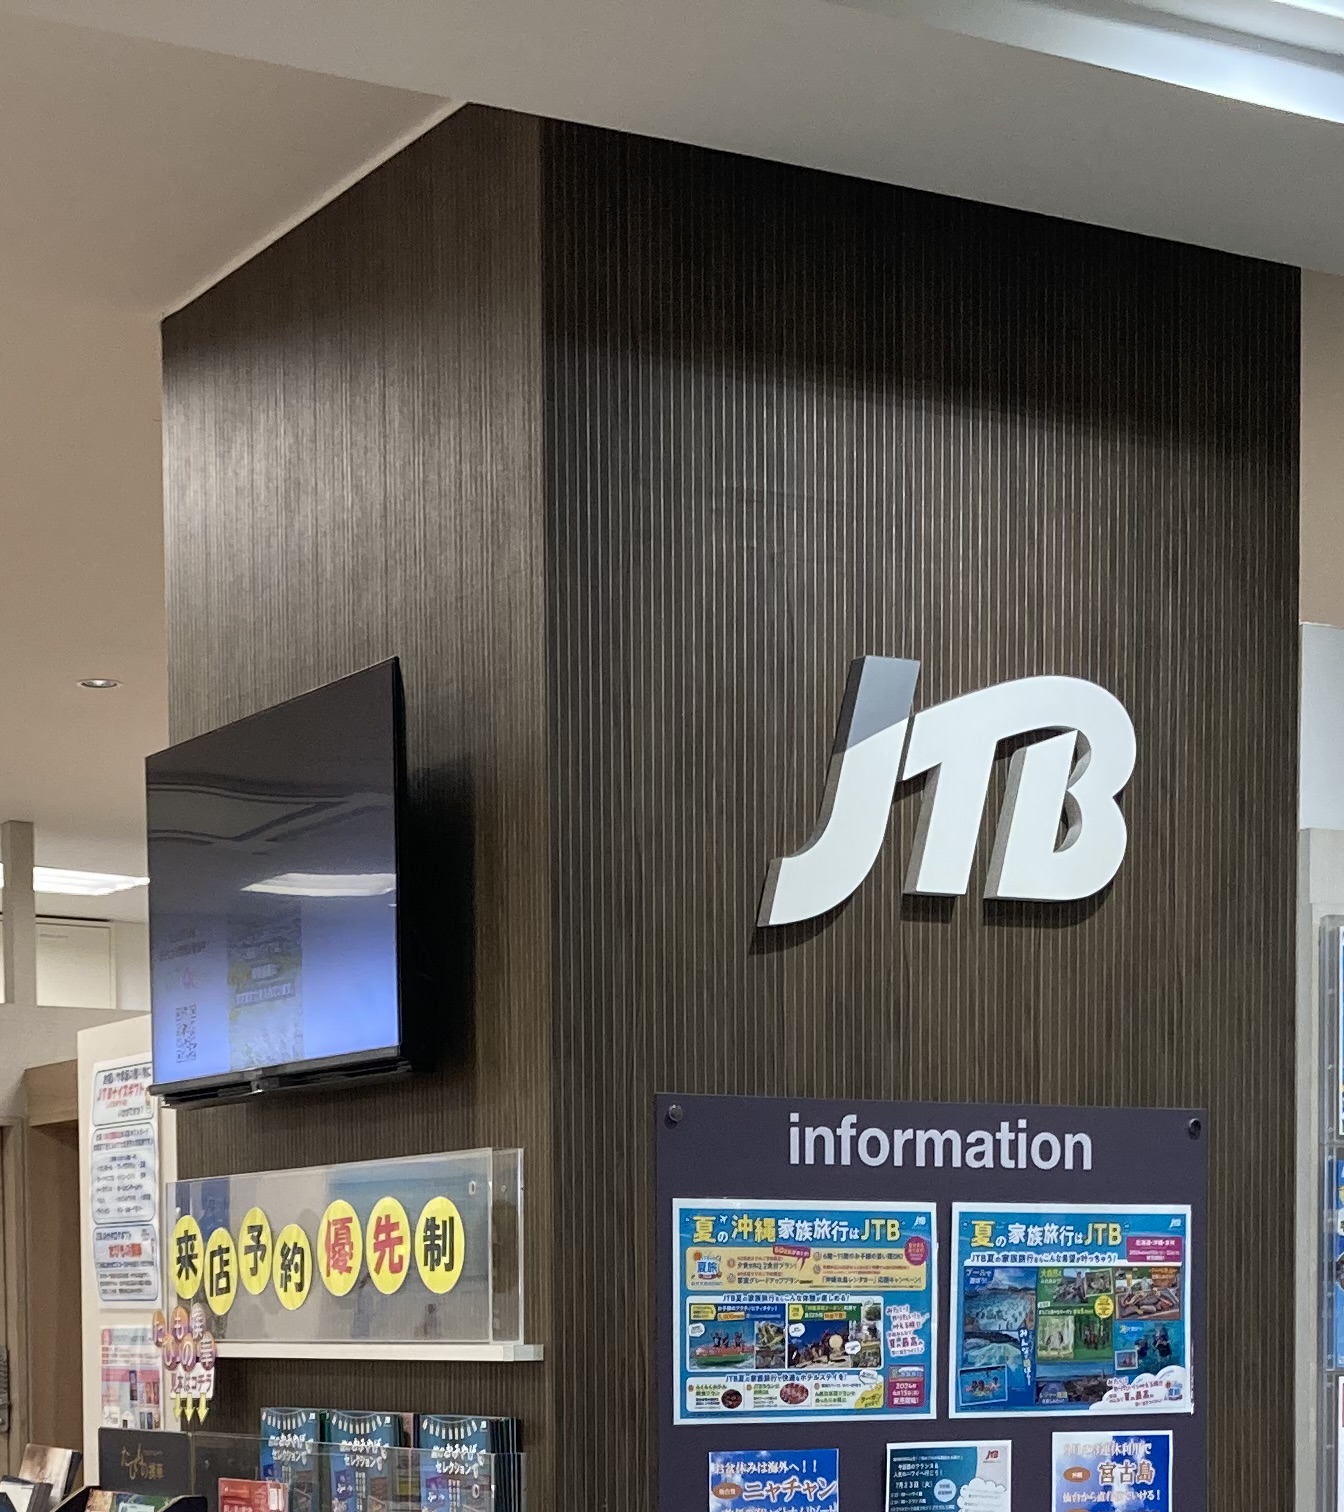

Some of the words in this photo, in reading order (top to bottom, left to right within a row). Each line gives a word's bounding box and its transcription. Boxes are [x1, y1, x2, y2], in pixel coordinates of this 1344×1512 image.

[757, 656, 1137, 927] JTB
[789, 1112, 1093, 1170] information
[176, 1216, 455, 1297] 来店予約優先制
[1099, 1461, 1154, 1486] 宮古島
